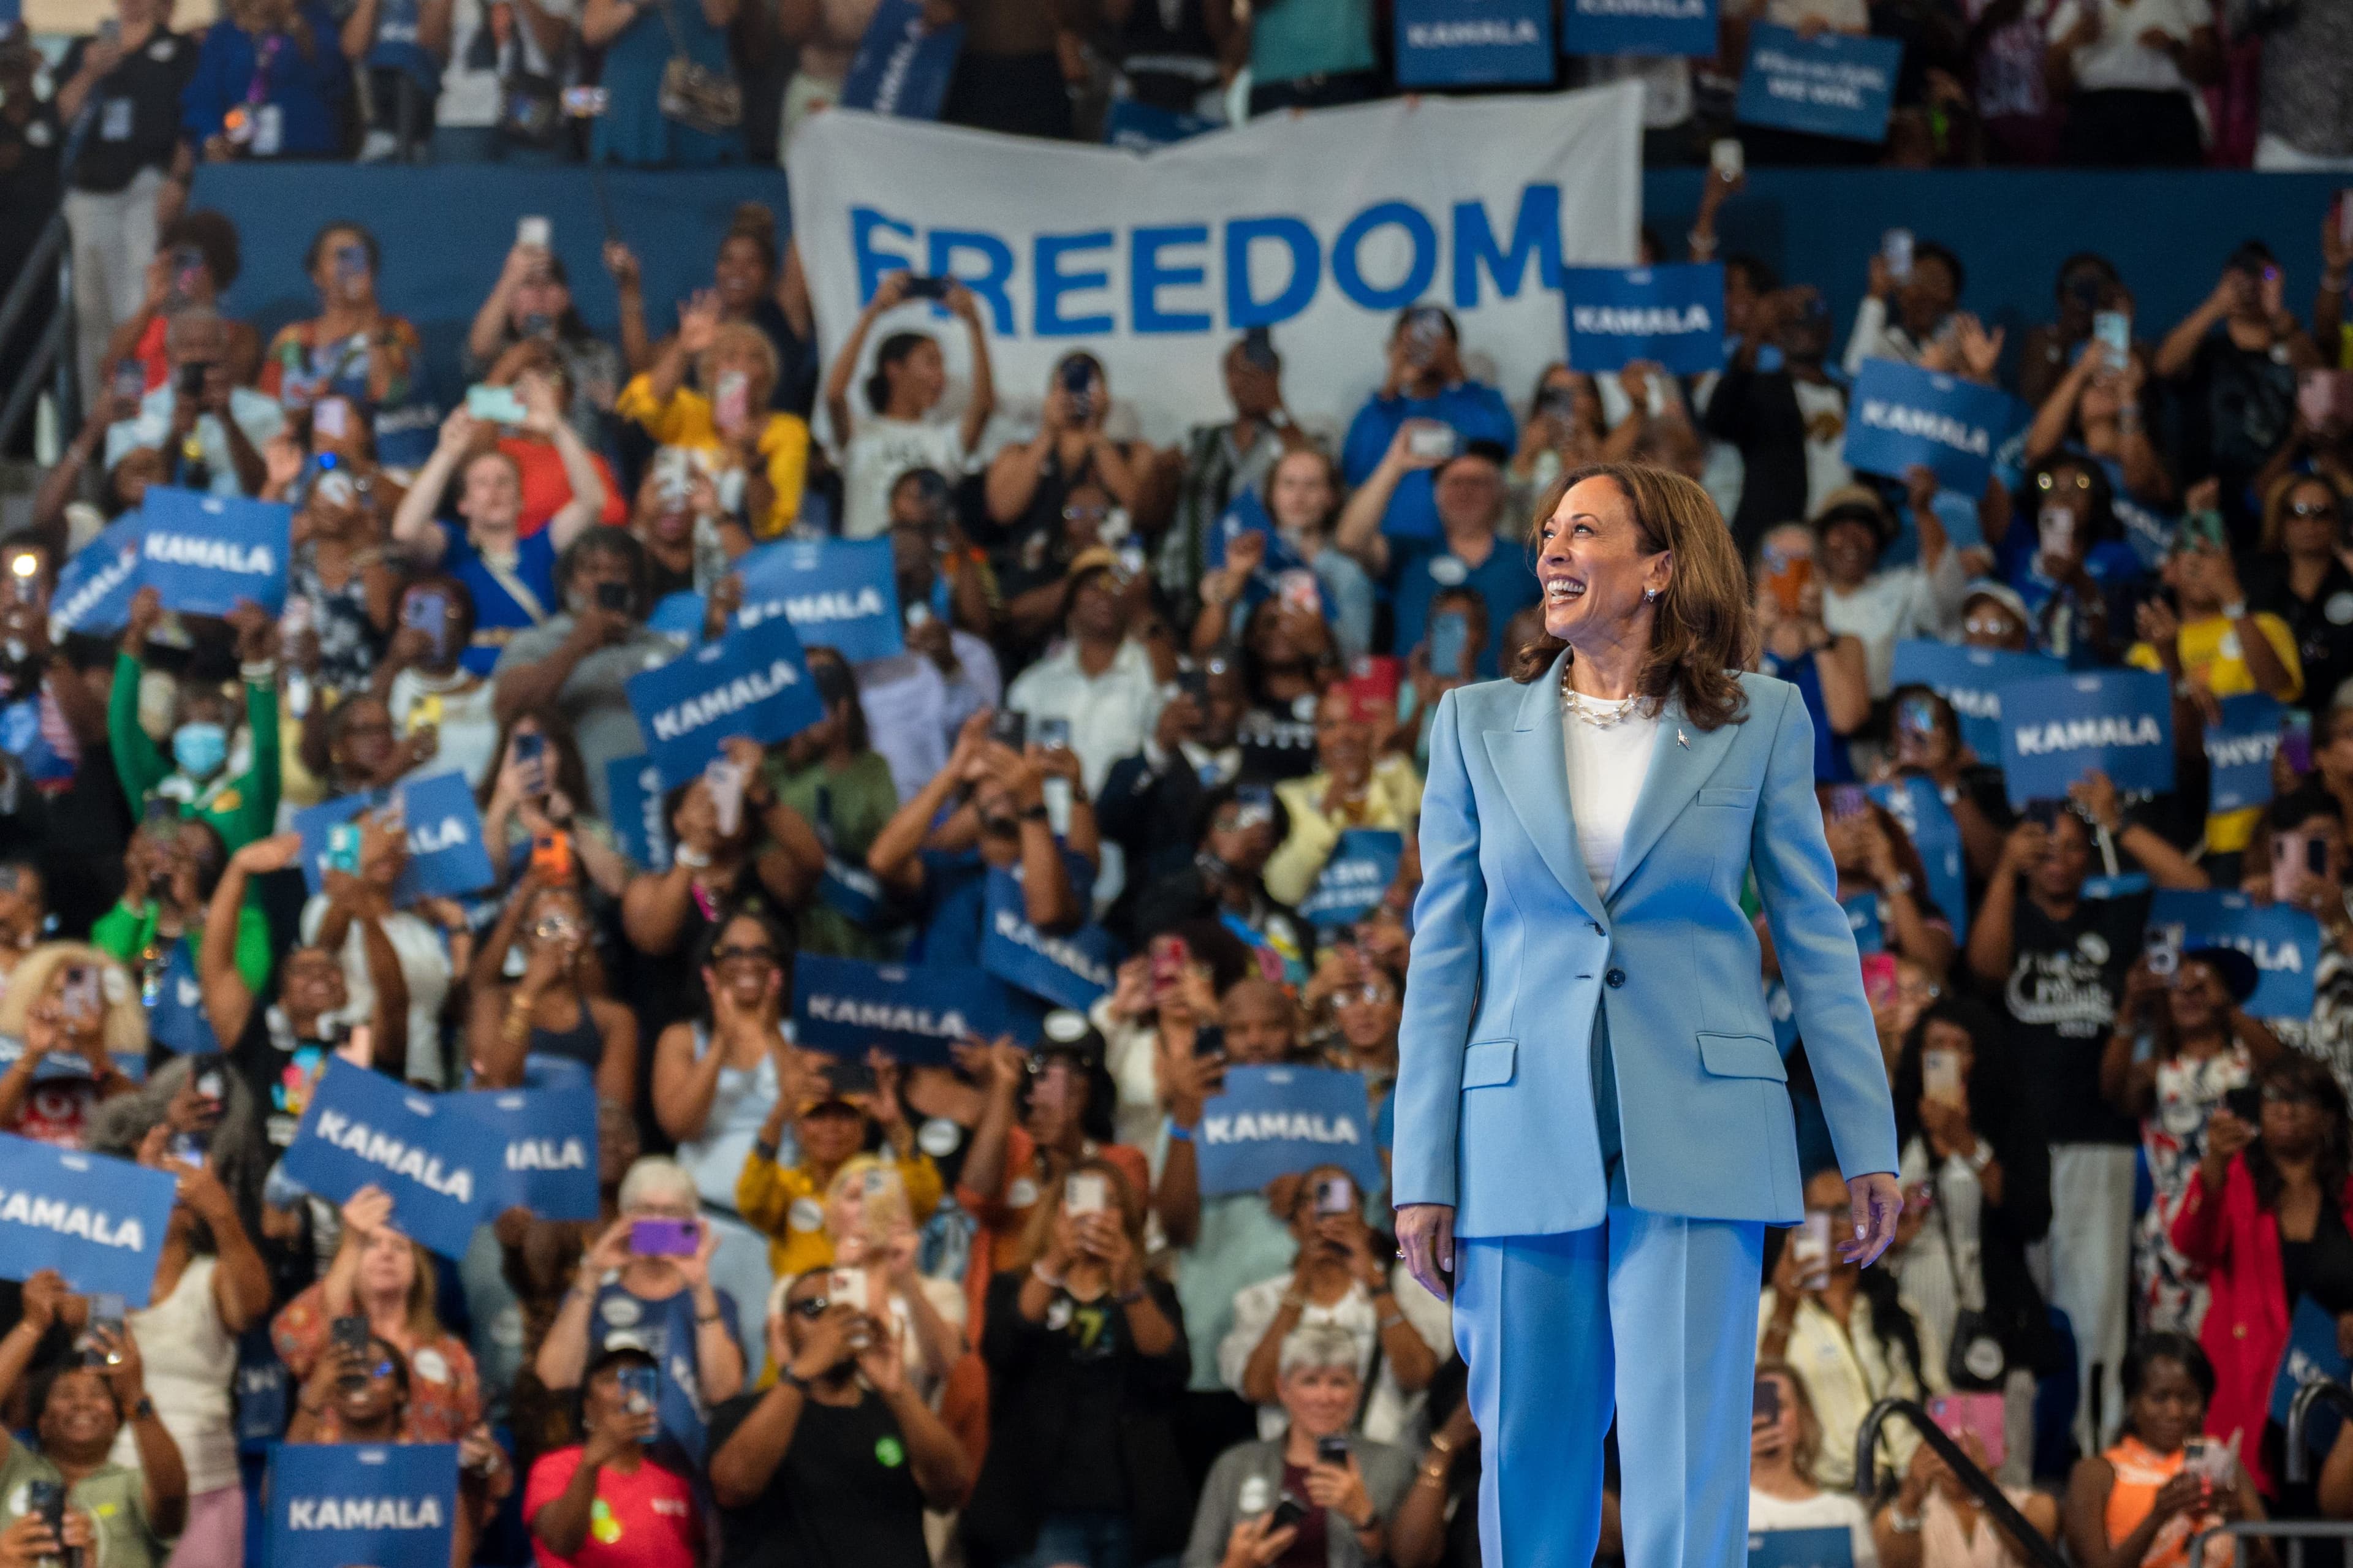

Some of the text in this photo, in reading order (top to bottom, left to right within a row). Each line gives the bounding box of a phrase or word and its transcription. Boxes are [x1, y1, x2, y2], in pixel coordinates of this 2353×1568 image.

[849, 183, 1564, 338] FREEDOM
[1572, 303, 1711, 335] KAMALA
[1860, 398, 1990, 457] KAMALA
[144, 531, 275, 576] KAMALA
[651, 659, 800, 741] KAMALA
[2015, 714, 2162, 756] KAMALA
[807, 994, 967, 1038] KAMALA
[1203, 1110, 1359, 1145] KAMALA
[316, 1108, 472, 1204] KAMALA
[0, 1189, 145, 1252] AMALA
[288, 1496, 442, 1530] KAMALA
